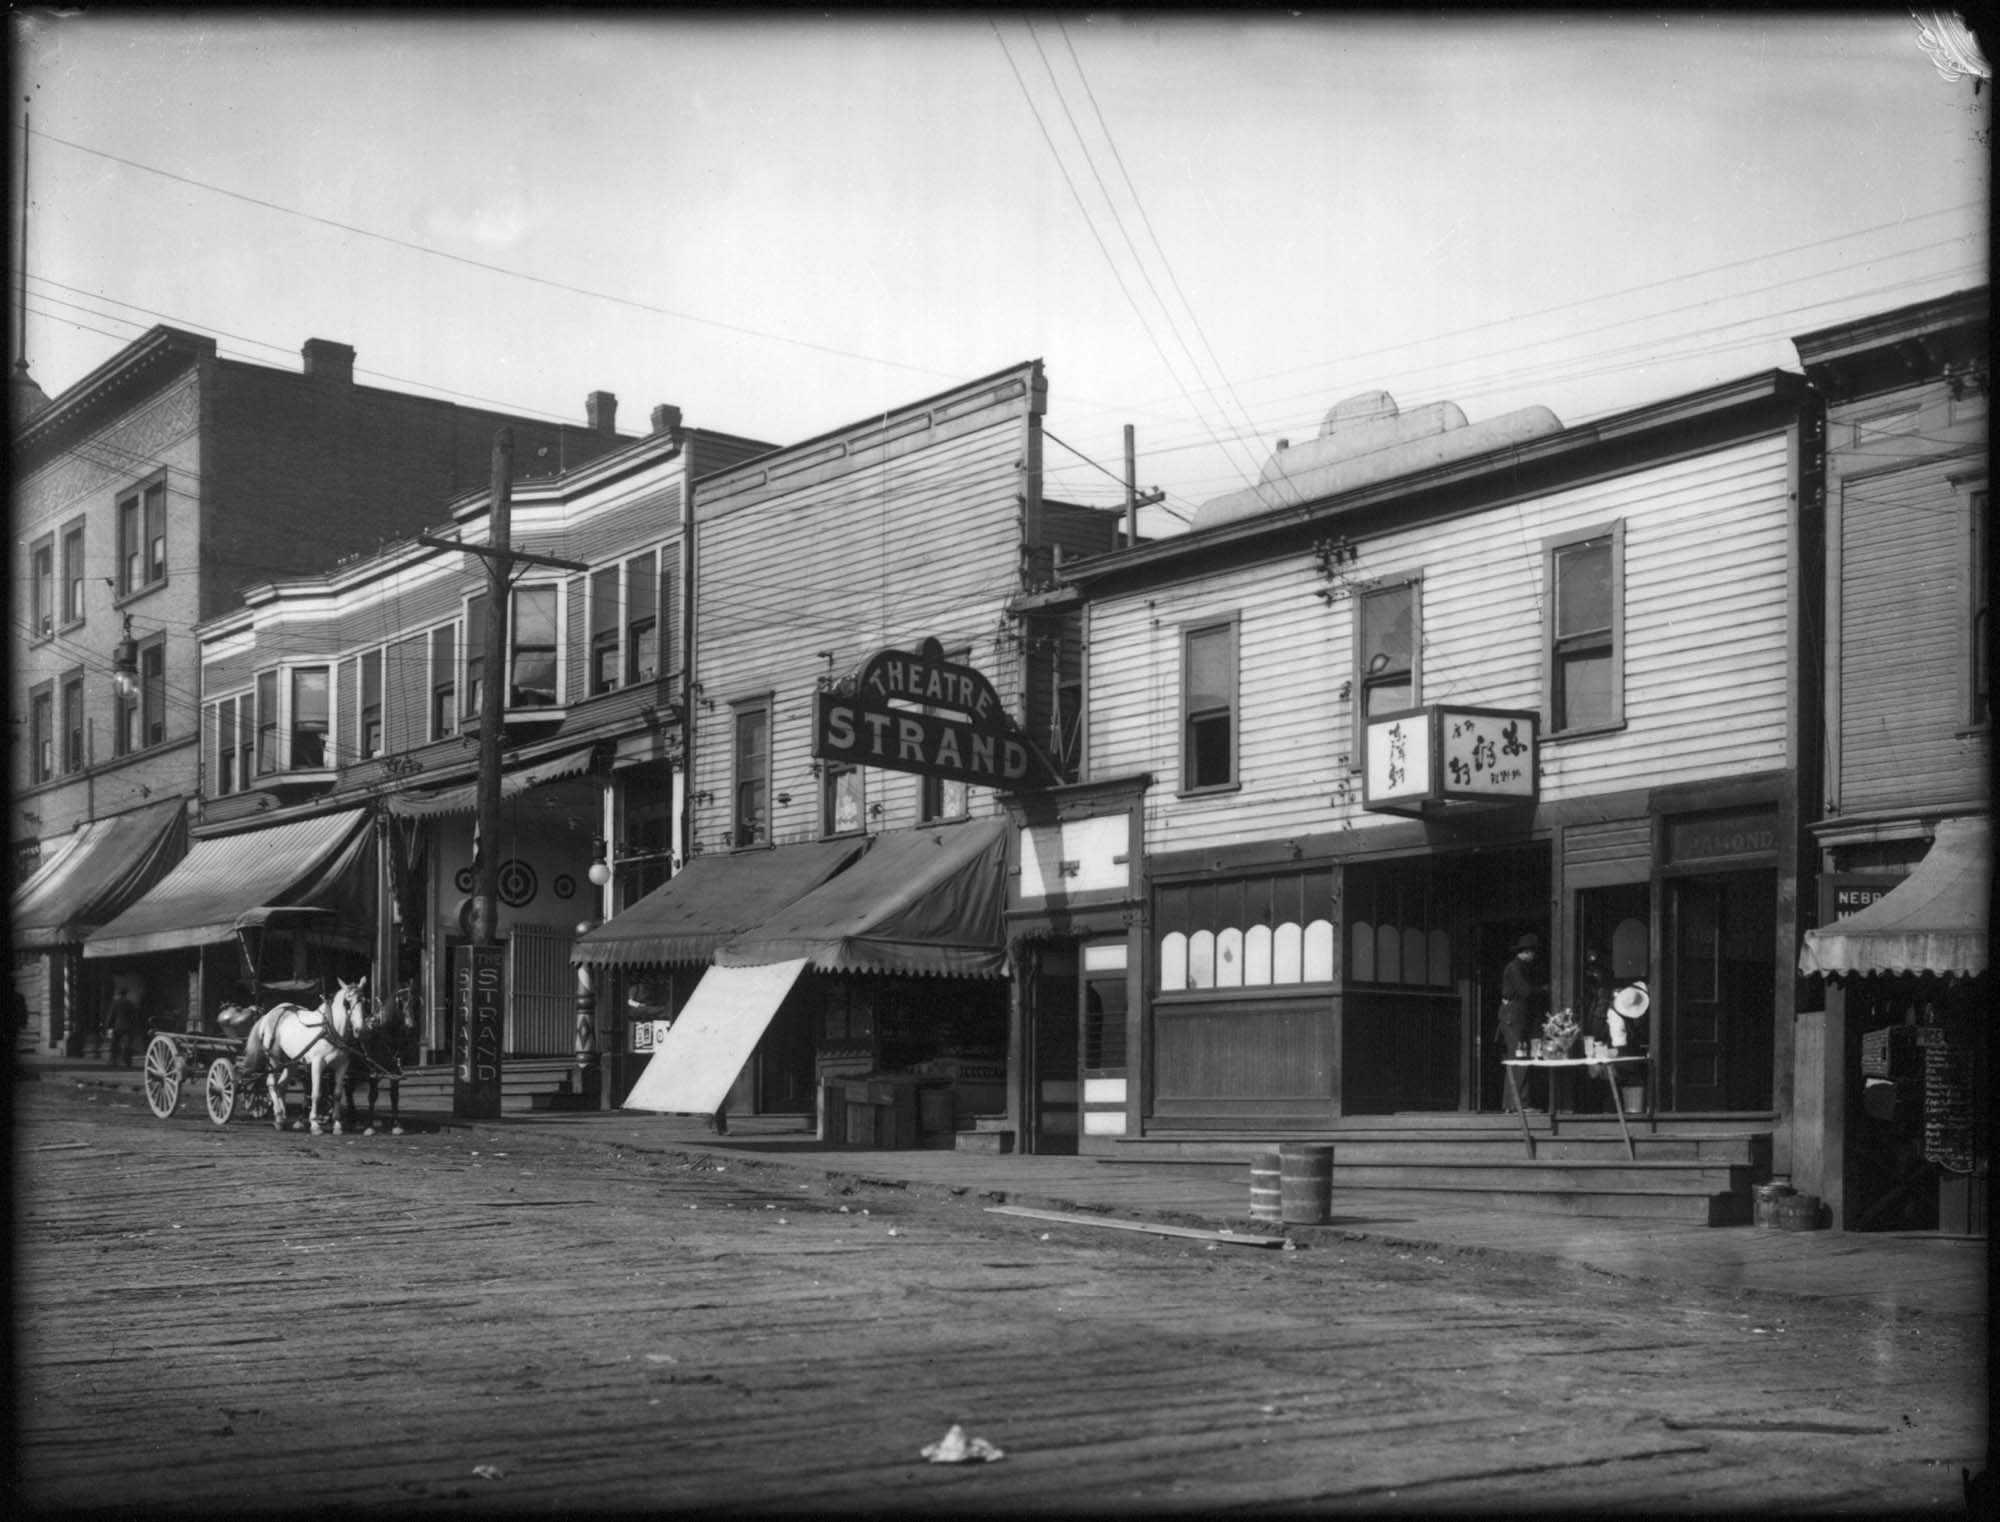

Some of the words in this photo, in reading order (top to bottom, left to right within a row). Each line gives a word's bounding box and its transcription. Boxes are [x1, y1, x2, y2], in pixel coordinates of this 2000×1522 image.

[868, 660, 993, 720] THEATRE
[827, 706, 1028, 778] STRAND
[457, 967, 471, 1083] STRAND
[476, 967, 499, 1081] STRAND
